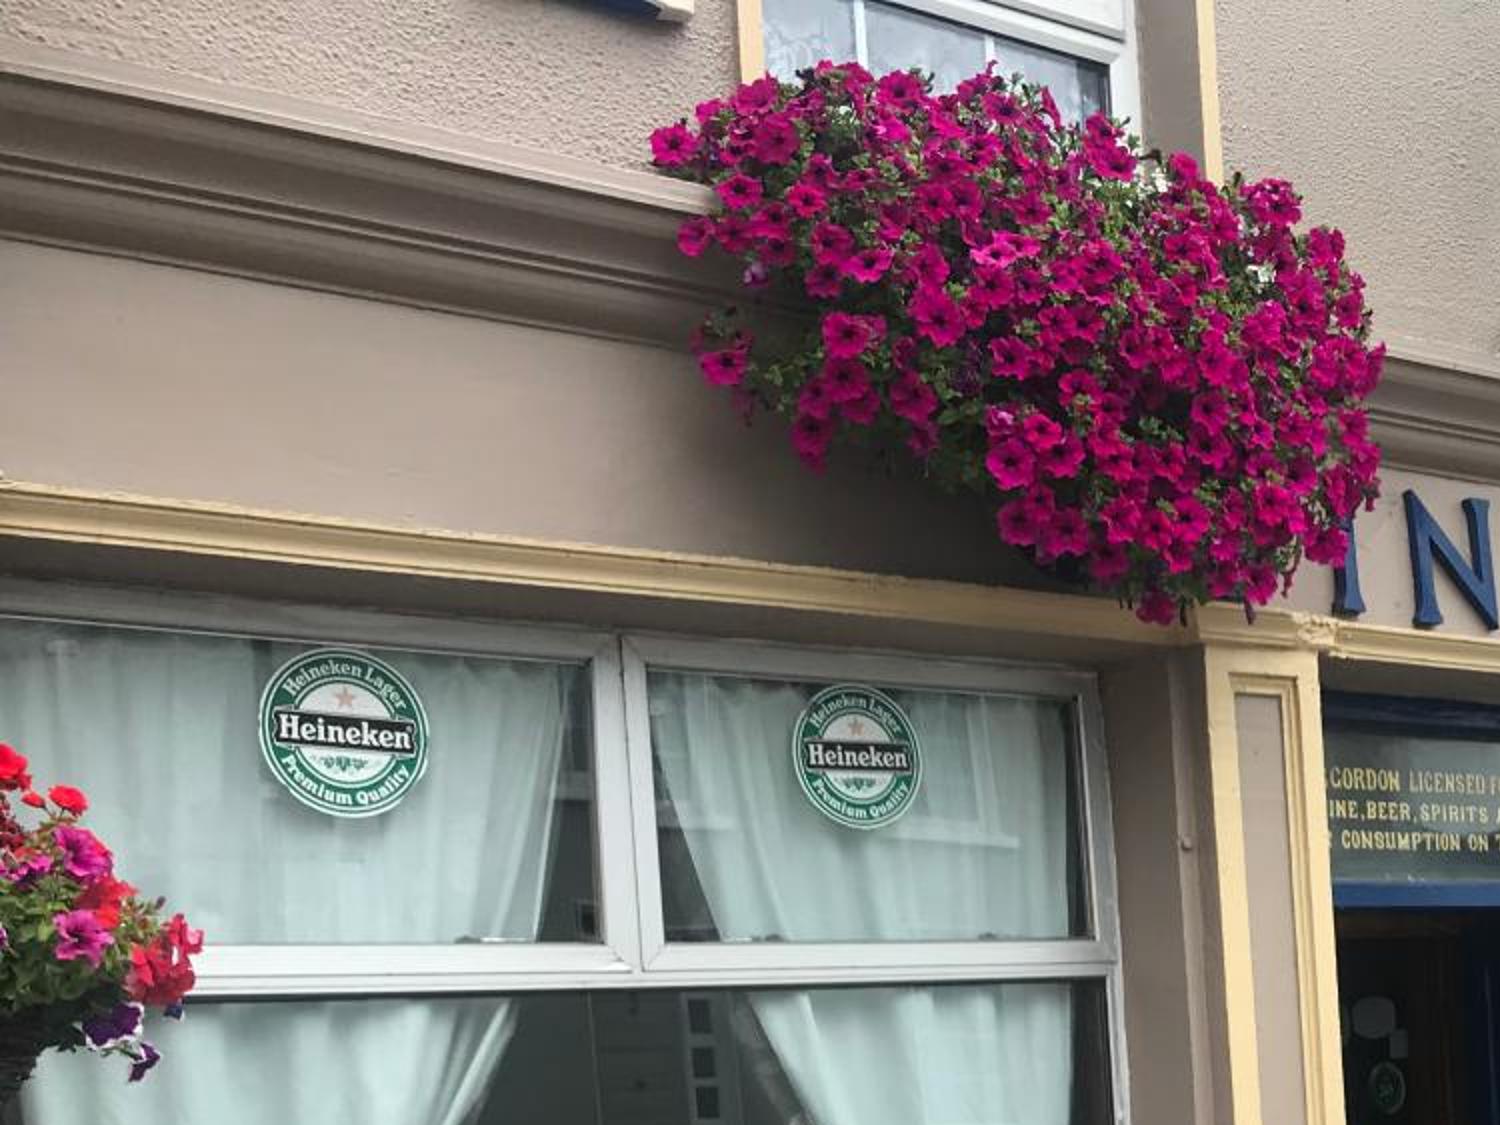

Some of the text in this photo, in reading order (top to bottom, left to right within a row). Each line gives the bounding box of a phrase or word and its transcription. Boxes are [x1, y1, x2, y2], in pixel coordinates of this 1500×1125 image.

[281, 660, 407, 710] Heineken Lager
[278, 713, 412, 749] Heineken
[807, 743, 908, 769] Heineken
[281, 755, 410, 806] Premium Quality
[1329, 766, 1400, 792] GORDON
[1409, 769, 1486, 795] LICENSED
[812, 778, 909, 819] Premium Quality
[1420, 802, 1489, 826] SPIRITS
[1341, 828, 1461, 852] CONSUMPTION
[1467, 833, 1489, 852] ON
